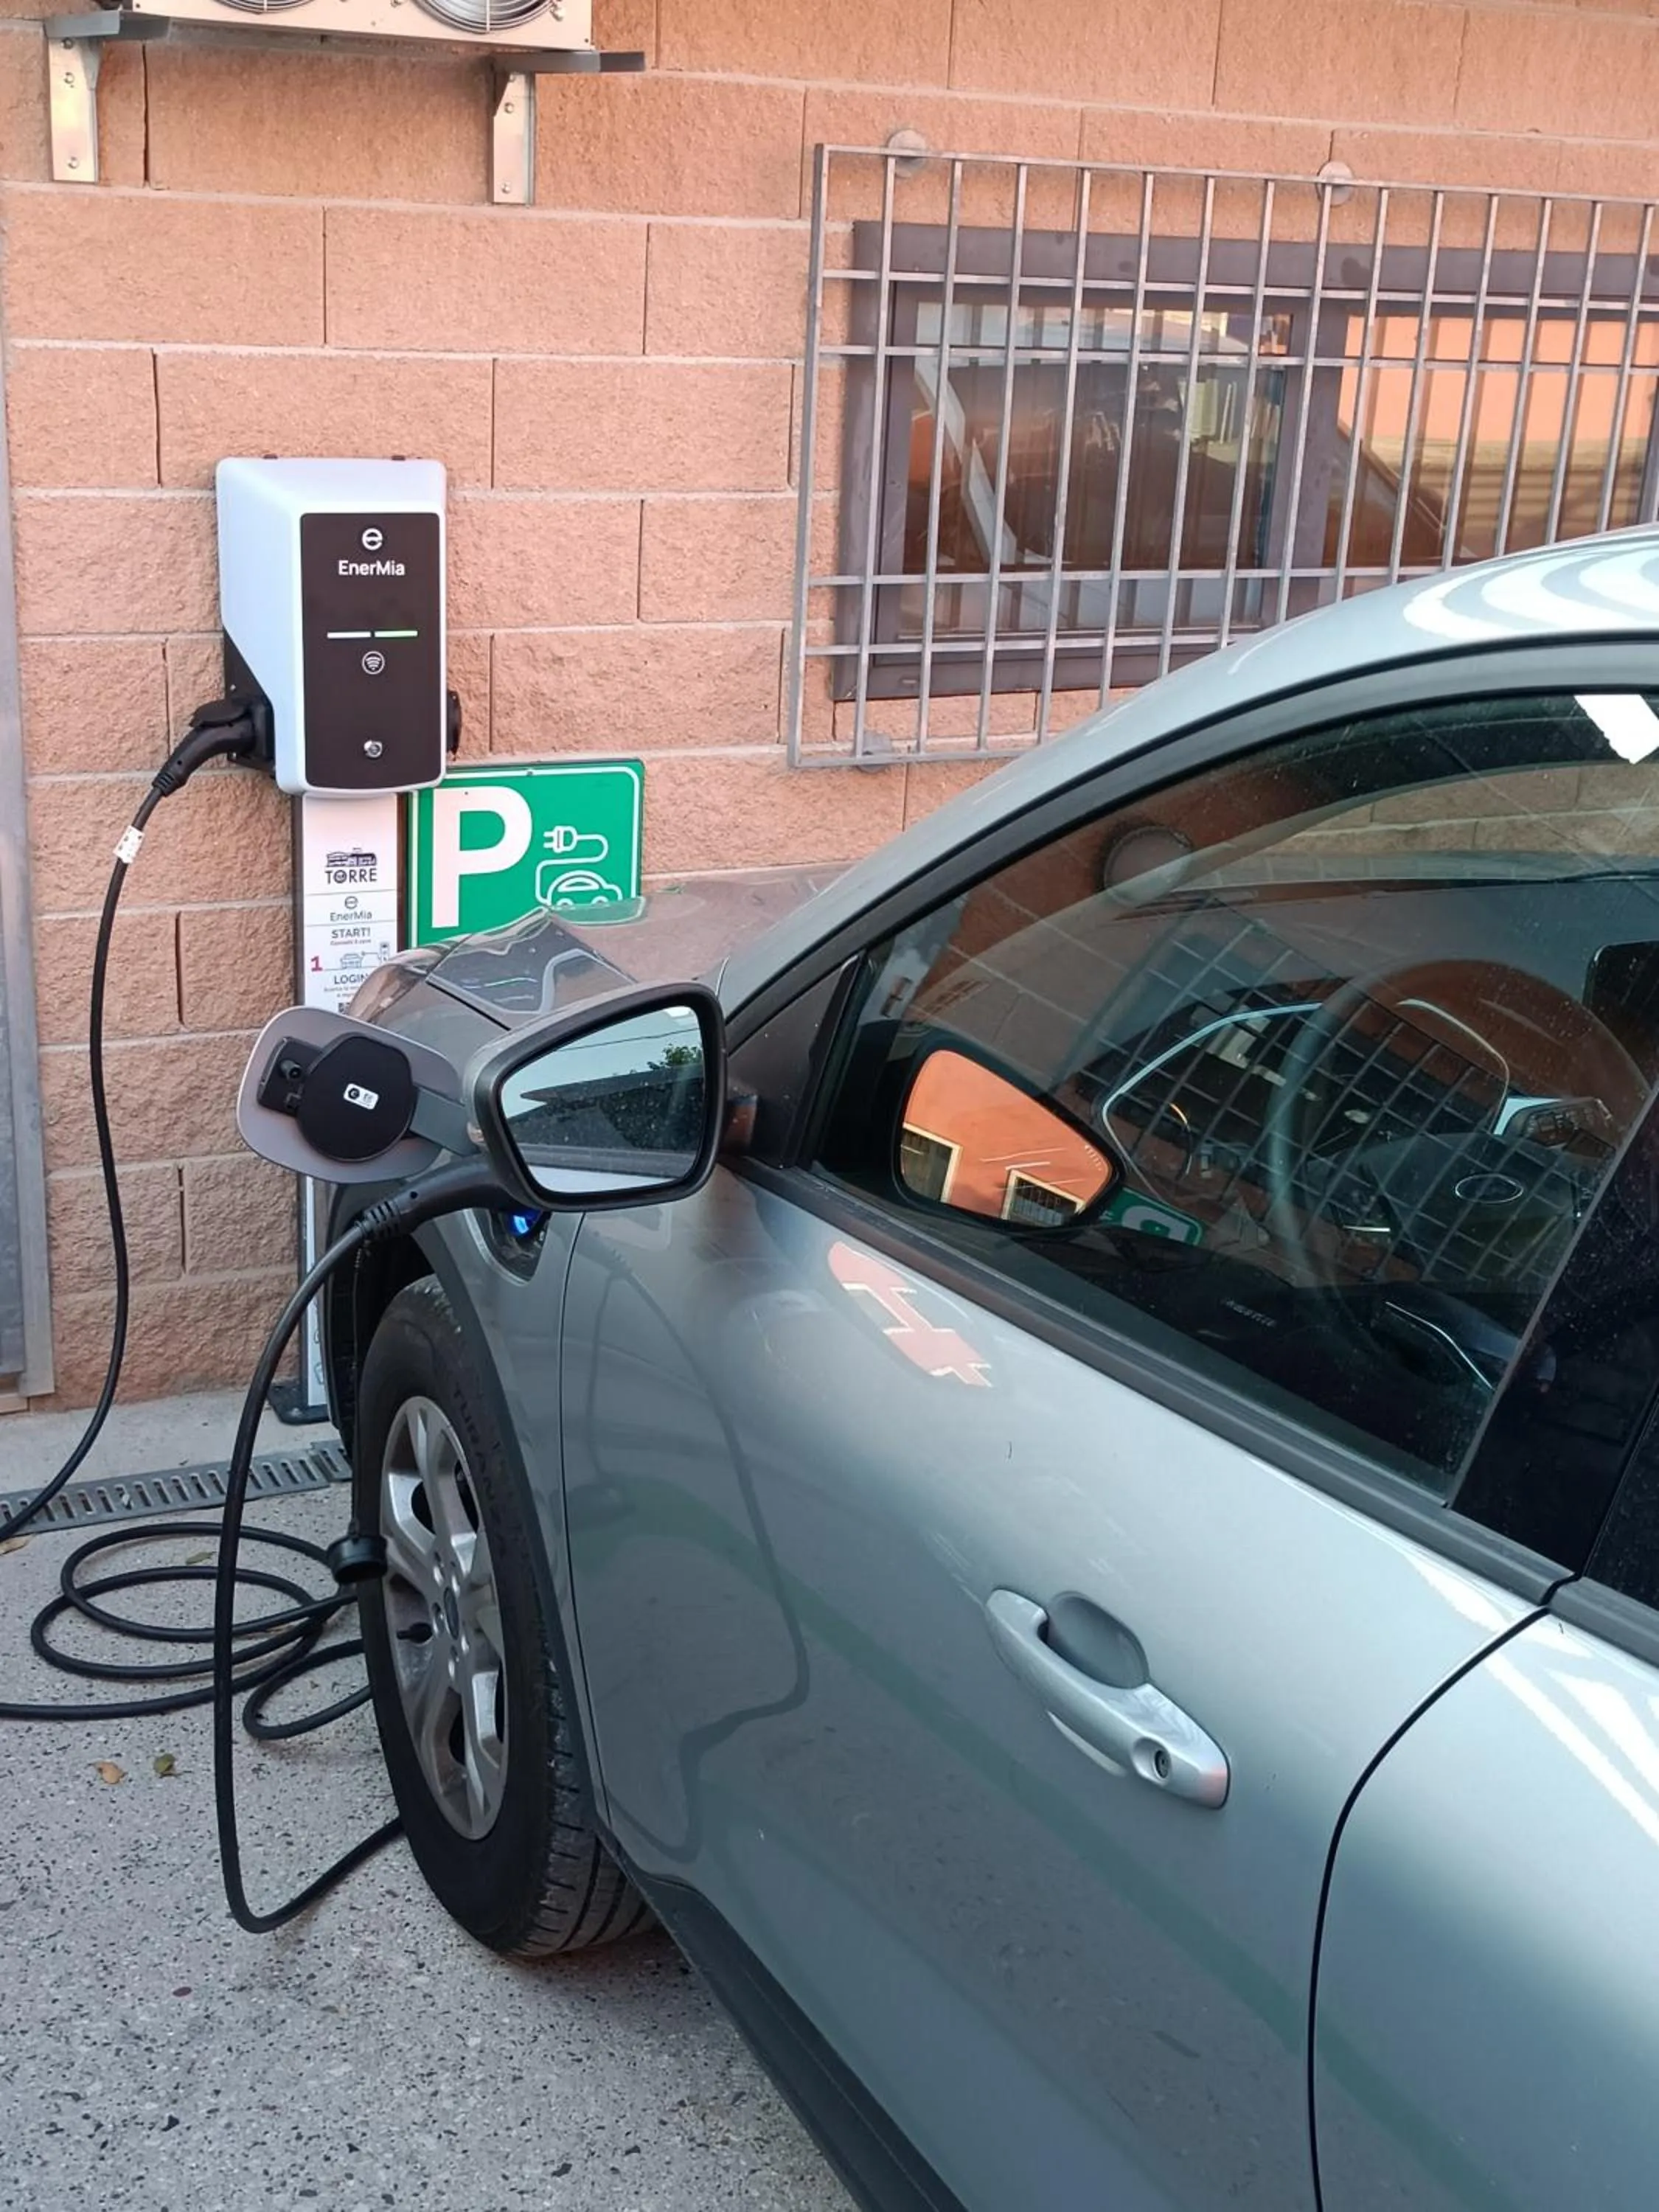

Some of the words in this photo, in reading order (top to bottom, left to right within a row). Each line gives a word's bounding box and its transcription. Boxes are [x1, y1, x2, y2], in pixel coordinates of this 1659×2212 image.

[338, 560, 406, 576] EnerMia
[431, 785, 533, 928] P
[324, 868, 378, 885] TORRE
[330, 911, 372, 922] EnerMia
[331, 927, 371, 939] START!
[310, 956, 323, 972] 1
